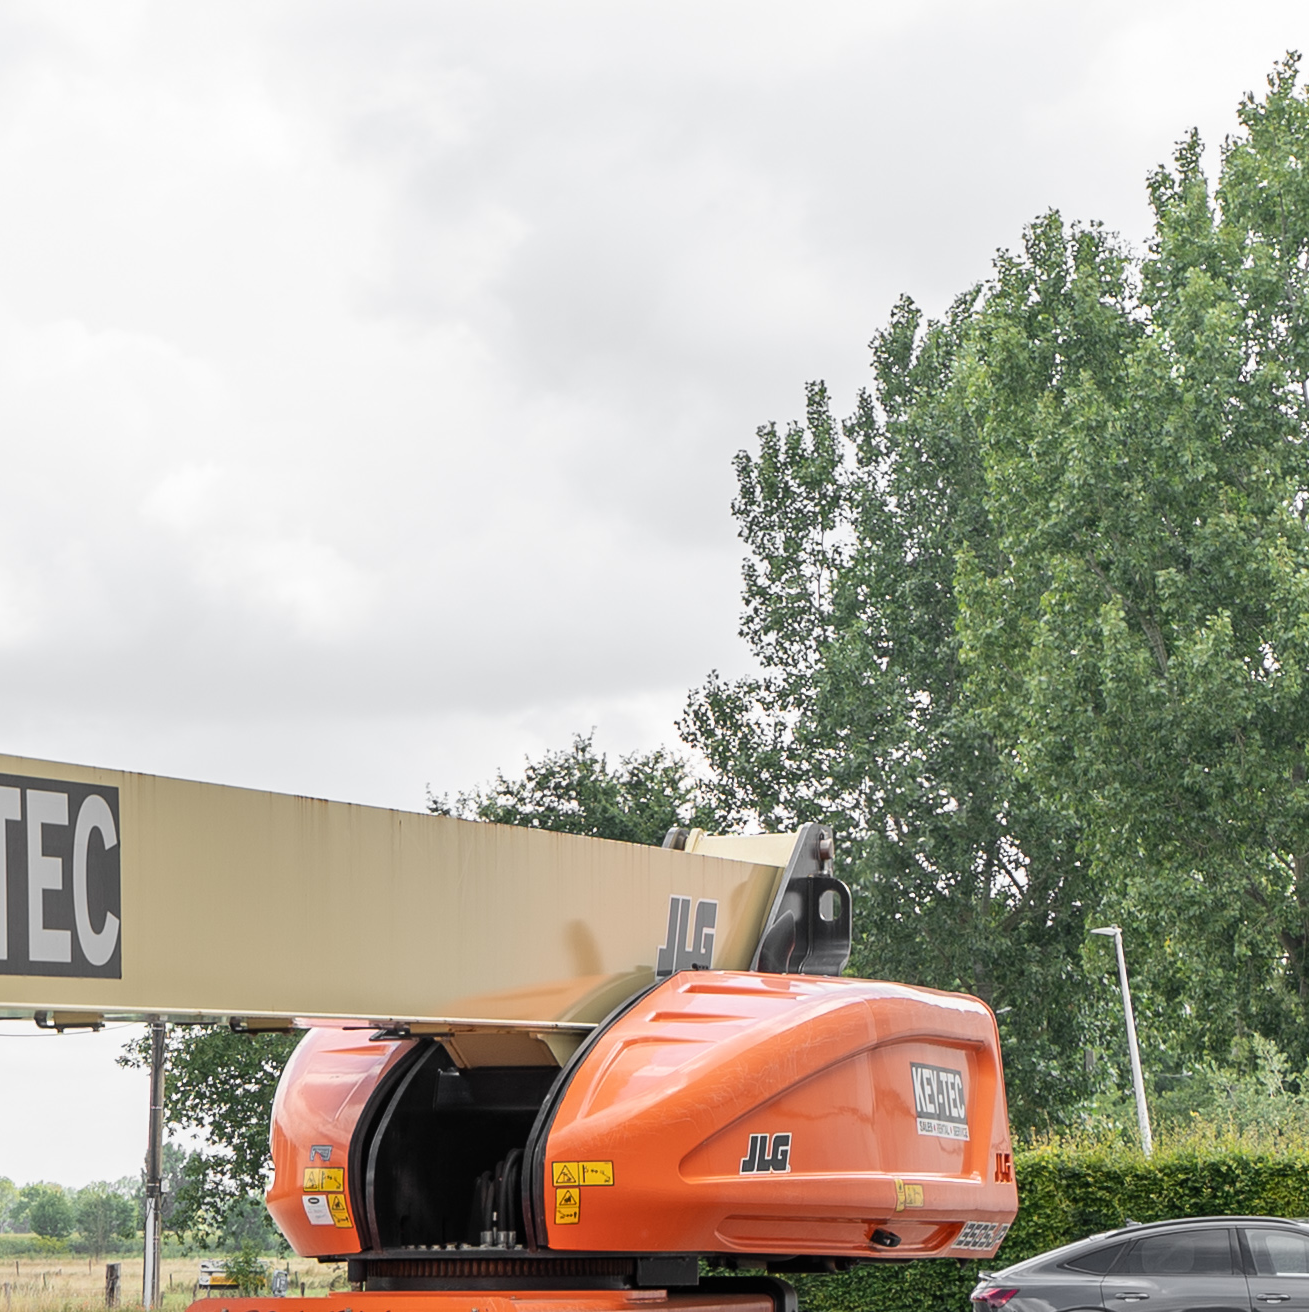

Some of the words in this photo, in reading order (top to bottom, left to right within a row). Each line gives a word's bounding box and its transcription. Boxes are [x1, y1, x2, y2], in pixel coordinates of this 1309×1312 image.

[656, 894, 719, 980] JLG
[912, 1067, 965, 1118] KEY-TEC
[740, 1133, 791, 1174] JLG
[994, 1152, 1012, 1183] JLG
